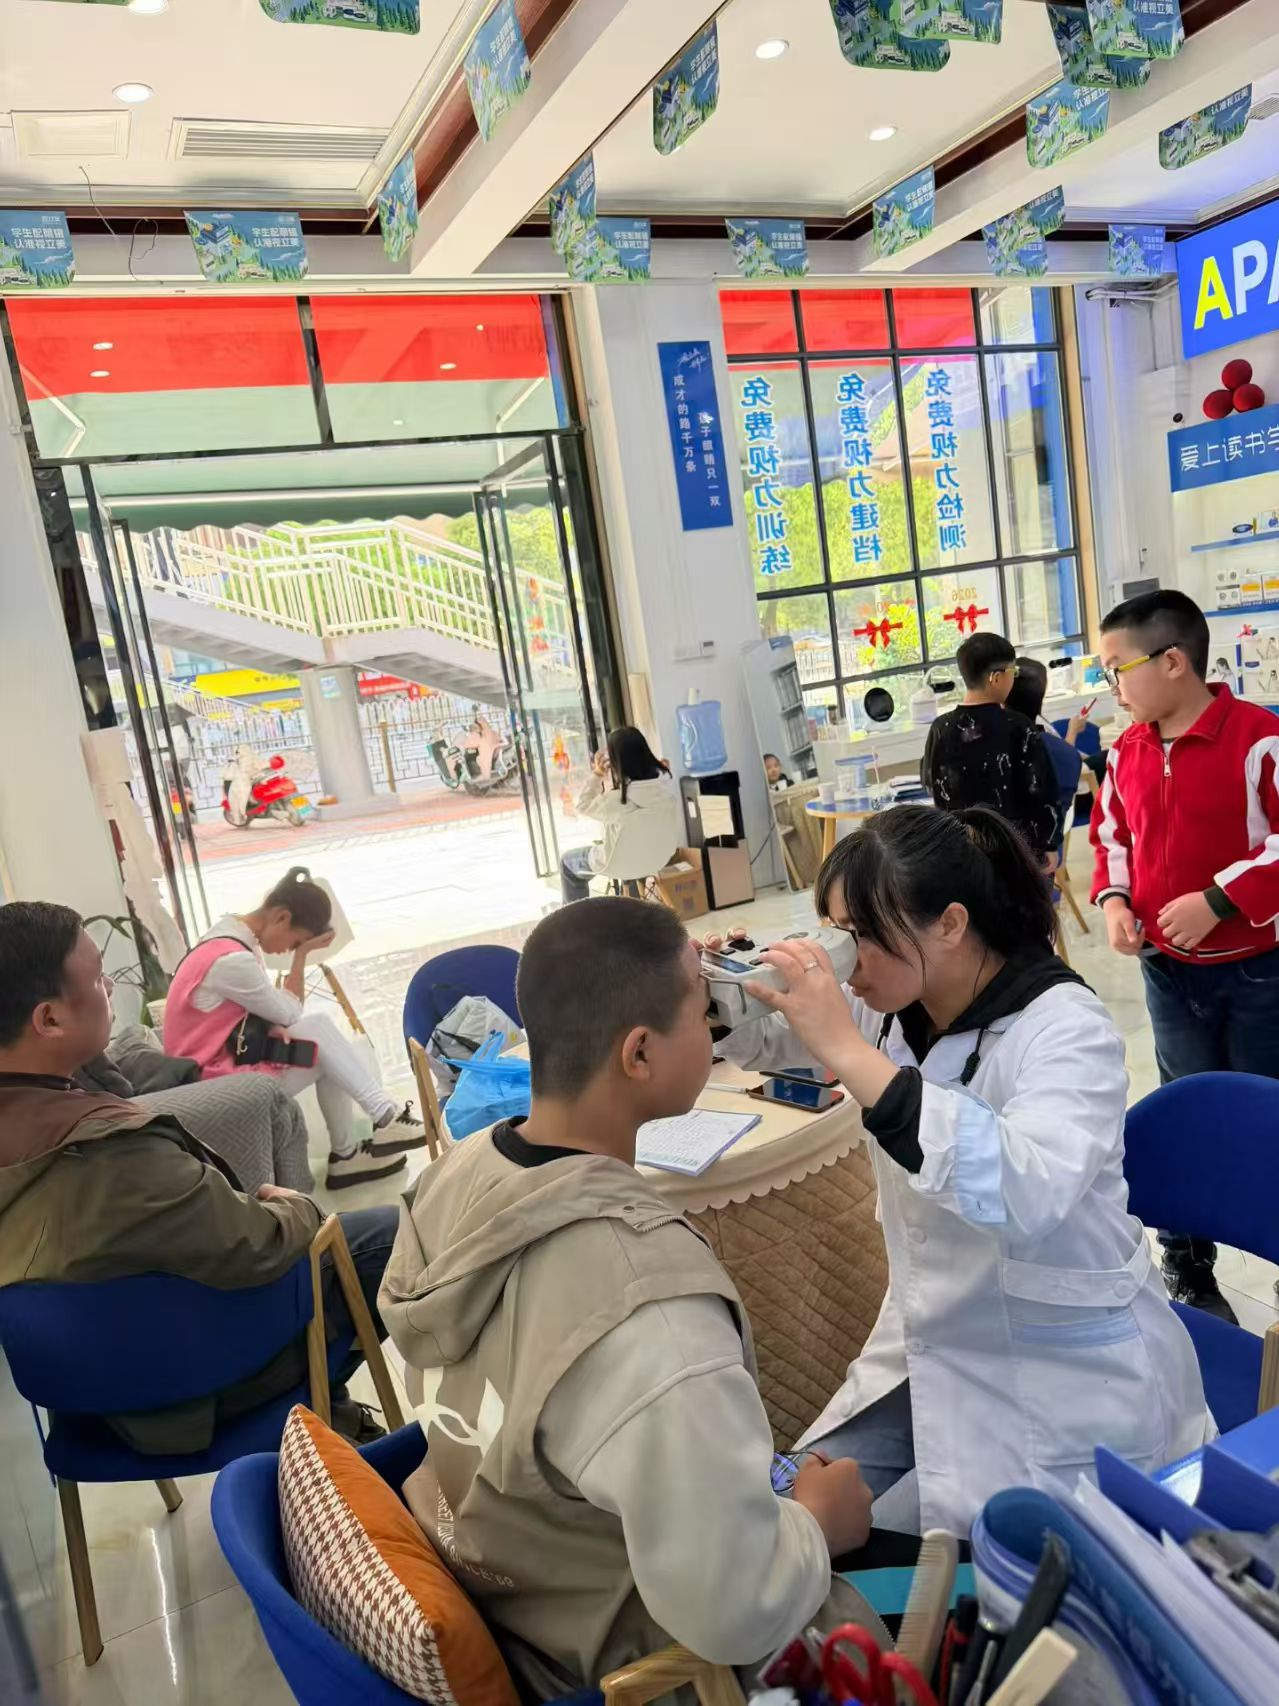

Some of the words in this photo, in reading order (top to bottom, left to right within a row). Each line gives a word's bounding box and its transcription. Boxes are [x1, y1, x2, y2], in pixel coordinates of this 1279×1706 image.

[11, 227, 65, 238] 学生配眼镜
[251, 227, 298, 237] 学生配眼镜
[14, 238, 67, 249] 认准视立美
[253, 237, 300, 248] 认准视立美
[1194, 239, 1279, 330] AP
[673, 374, 697, 472] 成才的路千万条
